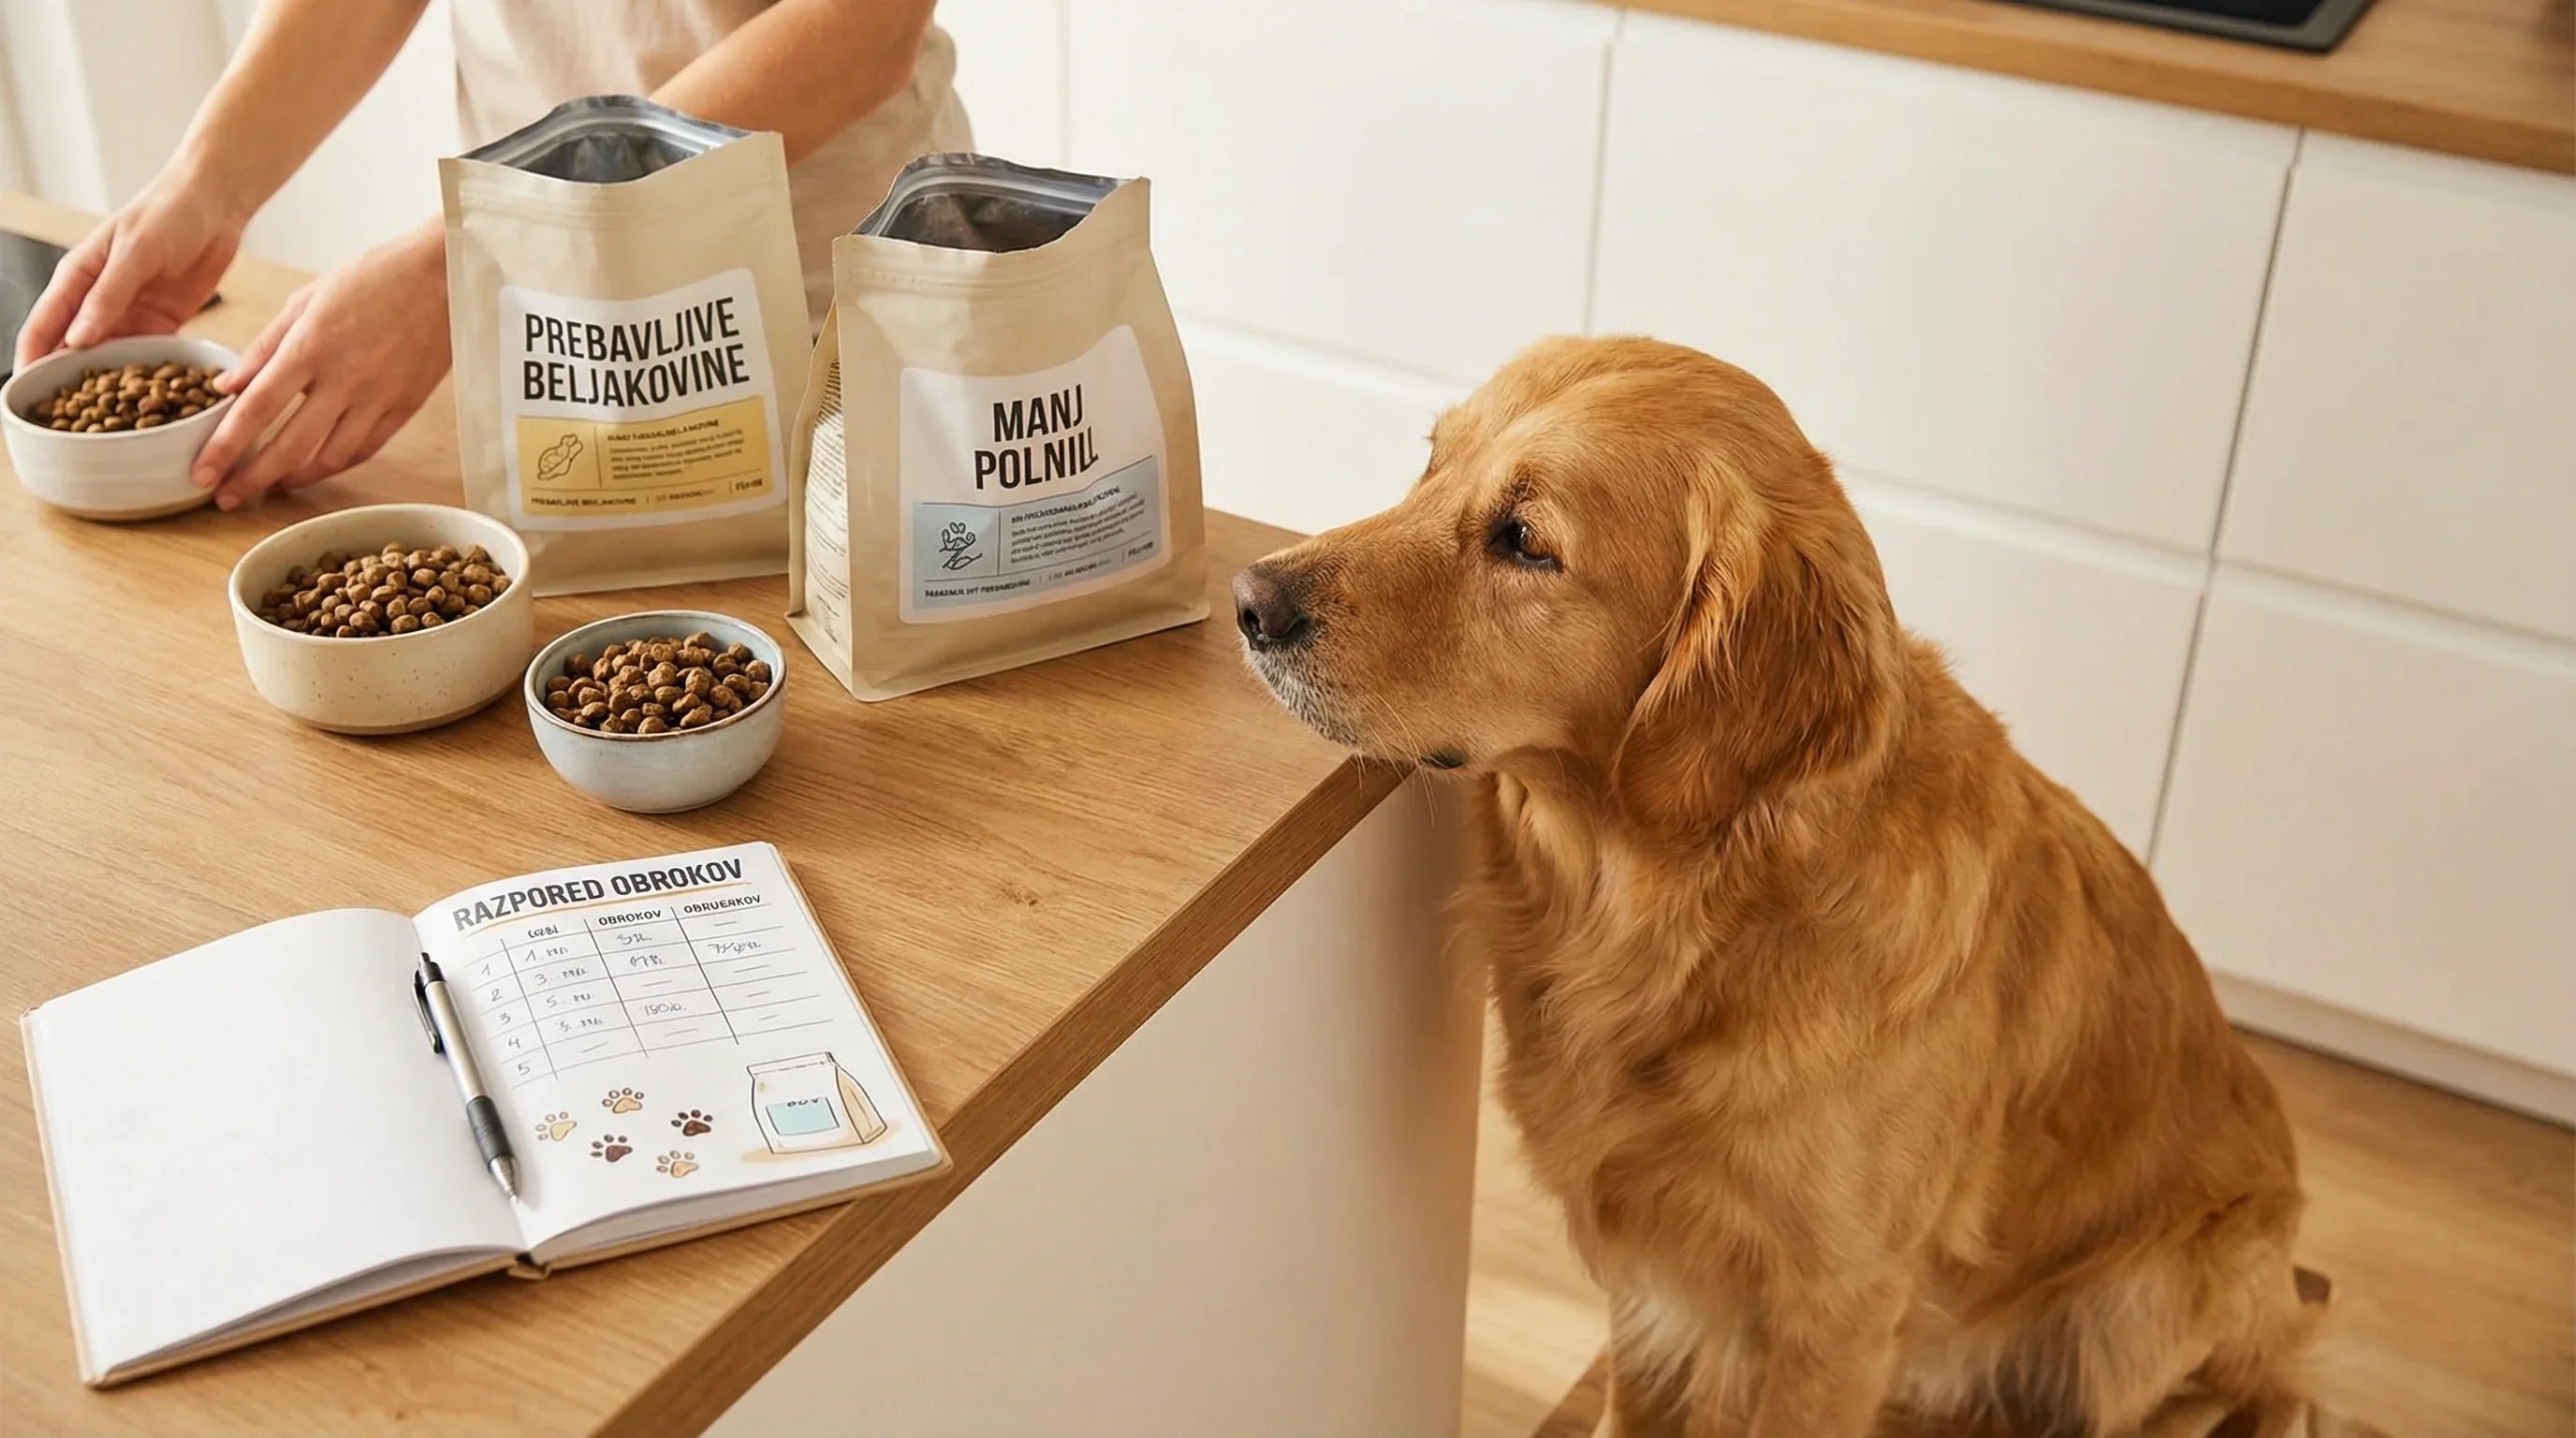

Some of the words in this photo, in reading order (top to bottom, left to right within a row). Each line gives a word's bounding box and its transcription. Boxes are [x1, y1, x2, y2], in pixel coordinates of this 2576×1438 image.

[524, 297, 739, 362] PREBAVLJIVE
[523, 344, 750, 406] BELJAKOVINE
[993, 384, 1083, 442] MANJ
[452, 878, 605, 932] RAZPORED
[611, 858, 743, 896] OBROKOV
[598, 910, 662, 926] OBROKOV
[490, 988, 503, 1002] 2
[499, 1012, 511, 1026] 3
[507, 1037, 521, 1049] 4
[517, 1060, 532, 1077] 5
